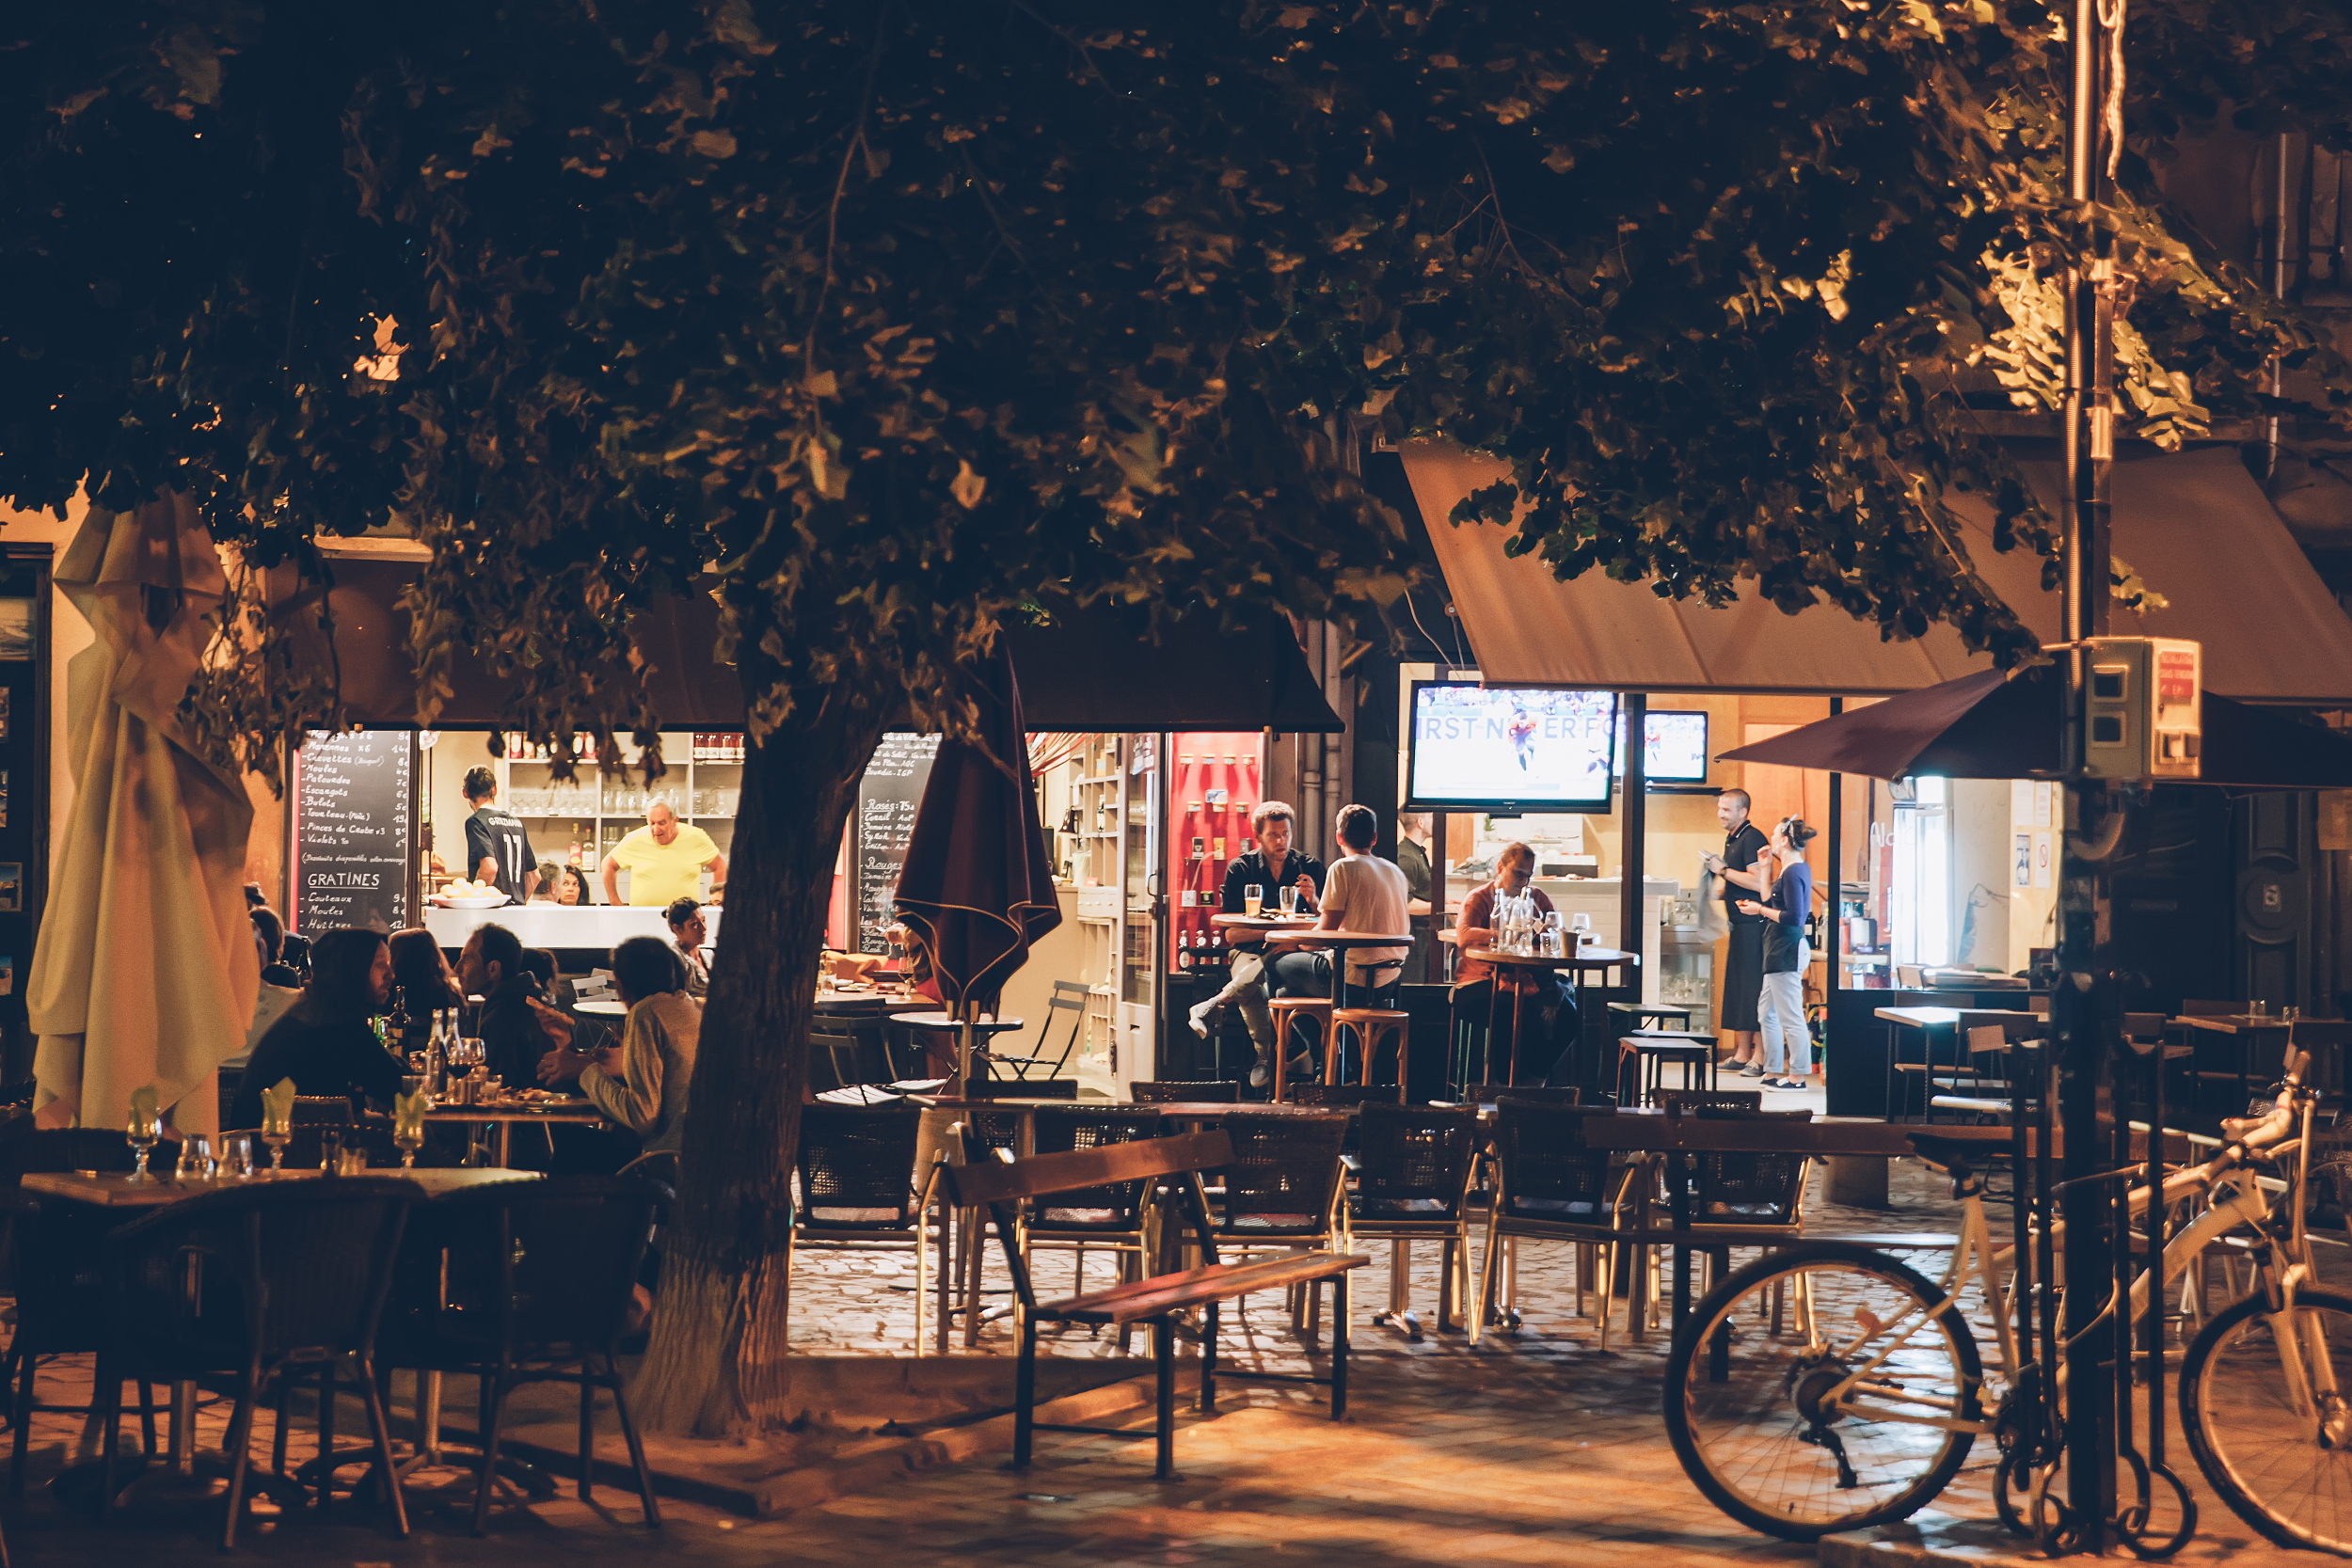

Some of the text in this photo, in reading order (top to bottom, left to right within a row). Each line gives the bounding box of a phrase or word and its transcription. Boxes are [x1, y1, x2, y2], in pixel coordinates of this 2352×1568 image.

[865, 856, 903, 874] Rouges
[307, 871, 380, 887] GRATINES
[309, 905, 343, 915] Moules
